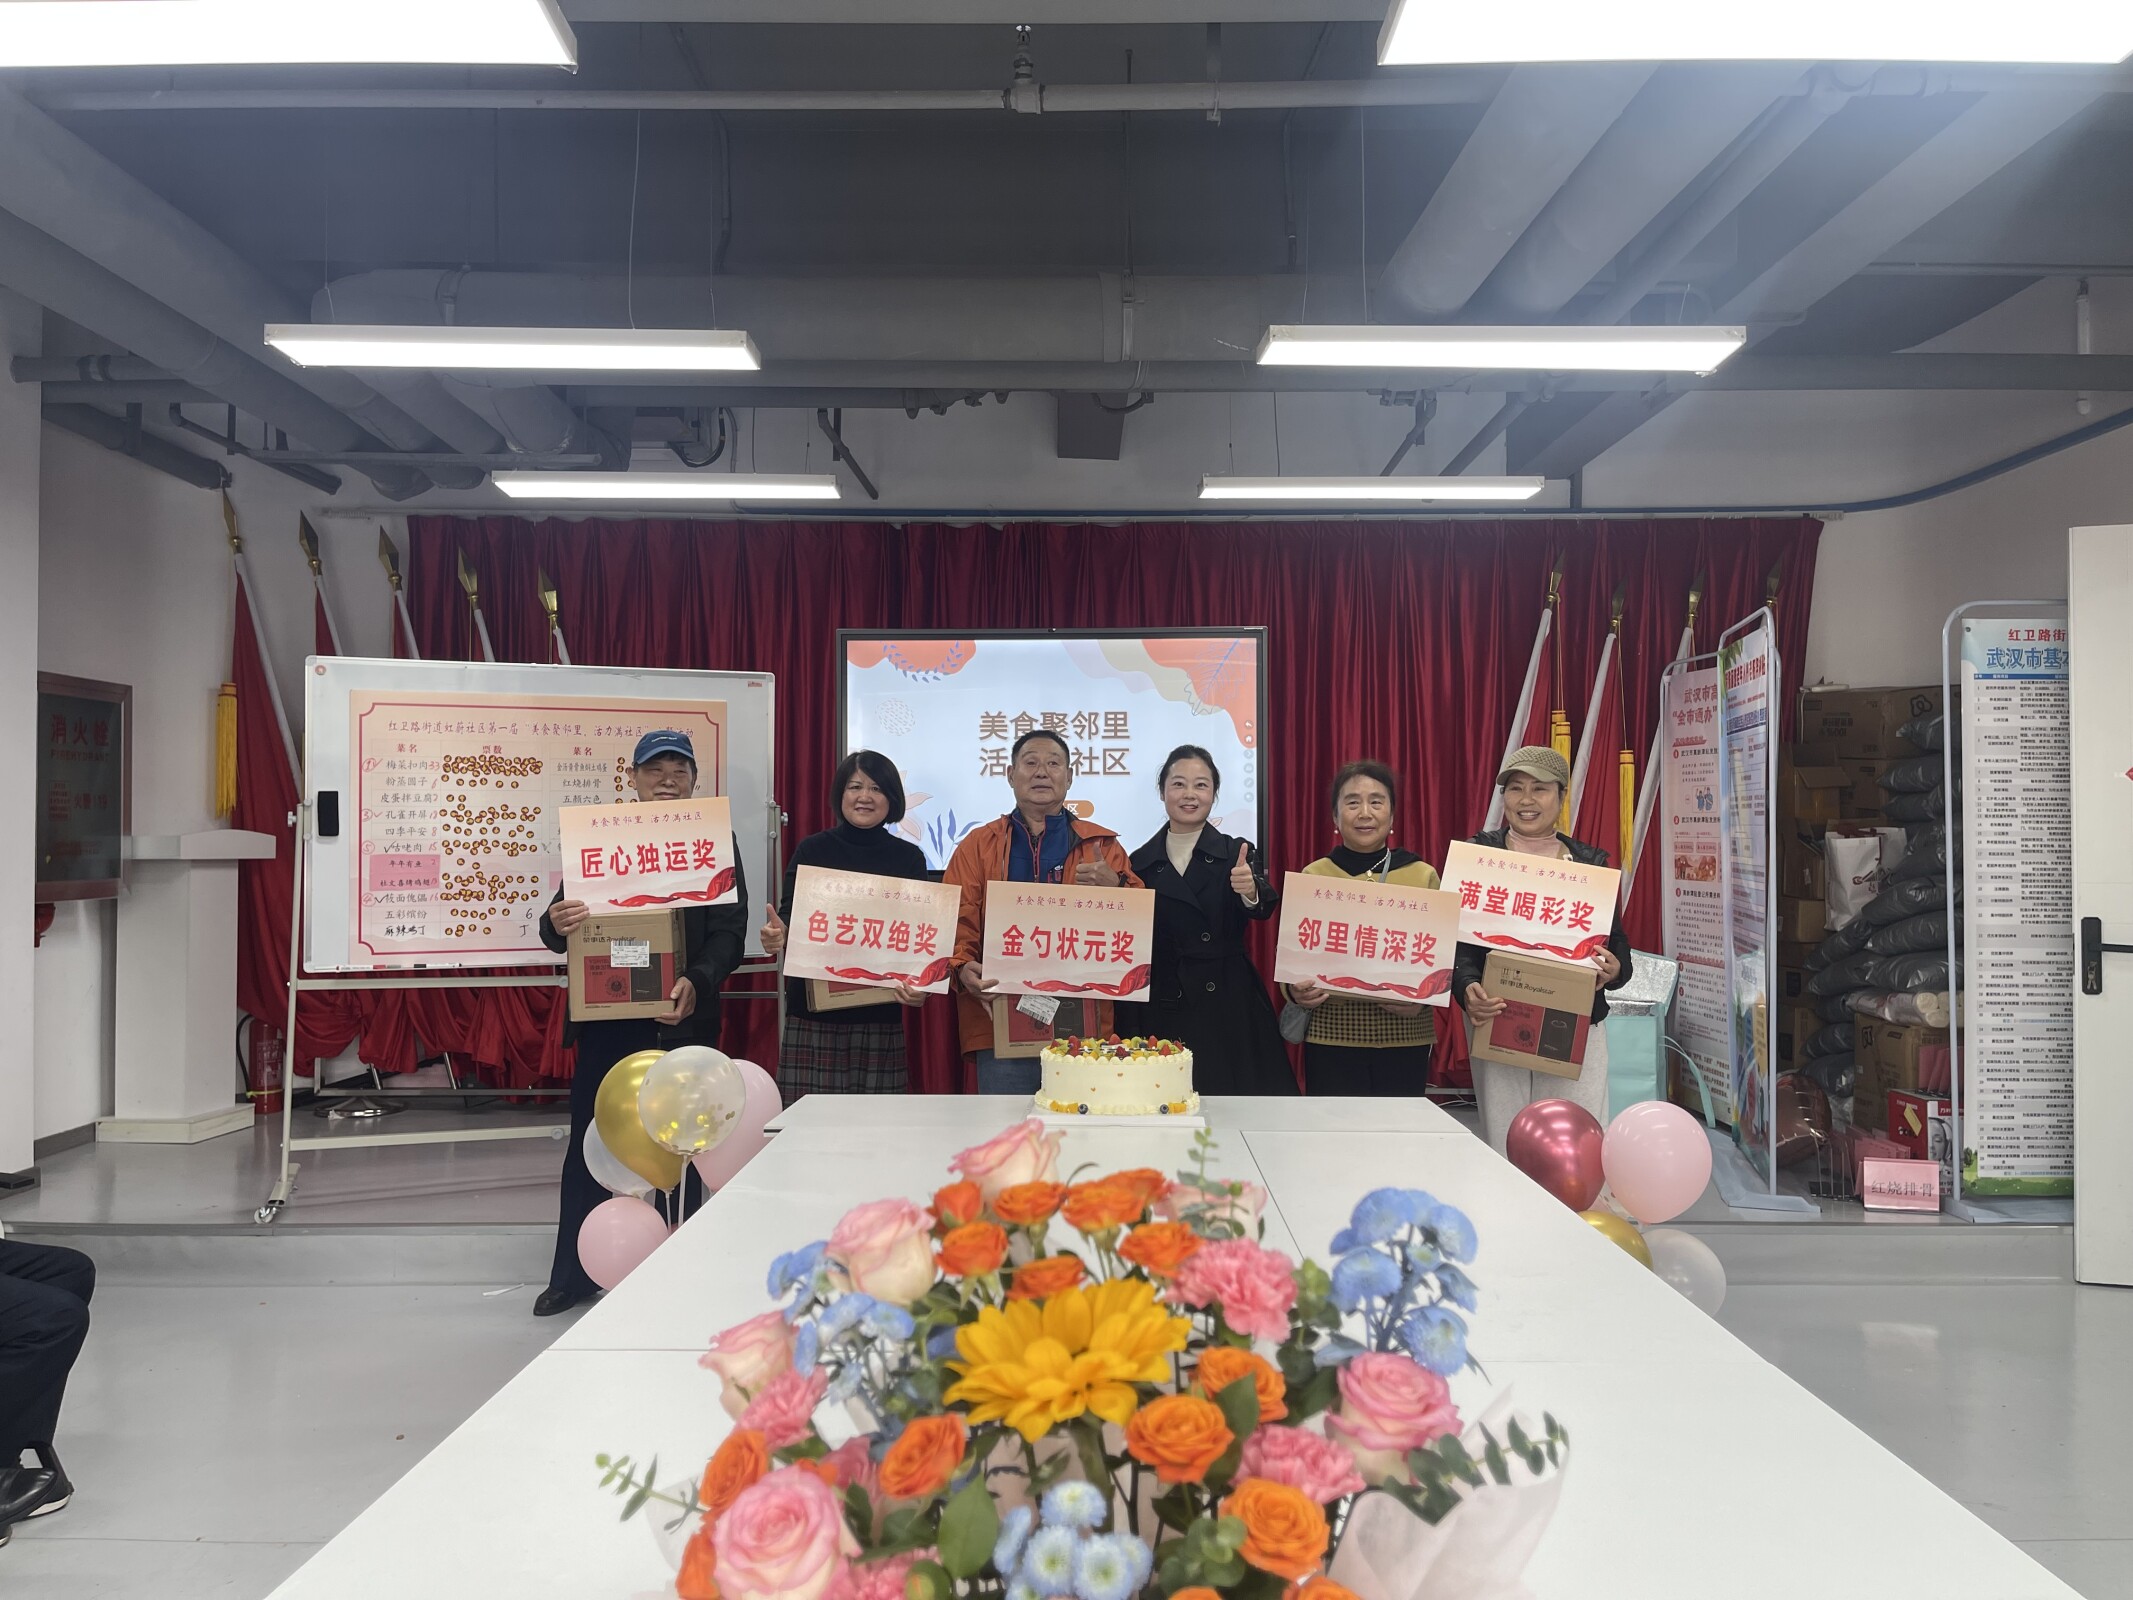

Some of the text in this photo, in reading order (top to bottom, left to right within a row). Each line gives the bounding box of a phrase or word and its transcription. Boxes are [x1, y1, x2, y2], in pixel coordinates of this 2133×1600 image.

[2008, 628, 2066, 642] 红卫路街
[50, 712, 109, 747] 消火栓
[979, 711, 1131, 741] 美食聚邻里
[396, 743, 418, 754] 菜名
[482, 744, 503, 755] 票数
[573, 746, 592, 756] 菜名
[386, 760, 428, 770] 梅菜扣肉
[979, 747, 1131, 777] 活社区
[562, 778, 602, 788] 红烧排骨
[381, 793, 432, 803] 皮蛋拌豆腐
[385, 809, 427, 820] 孔雀开屏
[591, 812, 702, 828] 美食聚邻里 活力满社区
[385, 825, 427, 837] 四季平安
[580, 839, 717, 879] 匠心独运奖
[1476, 856, 1590, 885] 美食聚邻里 活力满社区
[1015, 895, 1127, 912] 美食聚邻里 活力满社区
[1313, 888, 1430, 913] 美食聚邻里 活力满社区
[1457, 879, 1597, 933] 满堂喝彩奖
[385, 909, 428, 920] 五彩缤纷
[525, 907, 533, 920] 6
[807, 909, 941, 957] 色艺双绝奖
[1001, 924, 1136, 965] 金勺状元奖
[1297, 917, 1439, 968] 邻里情深奖
[1524, 983, 1556, 995] Royalstar
[1871, 1180, 1935, 1198] 红烧排骨
